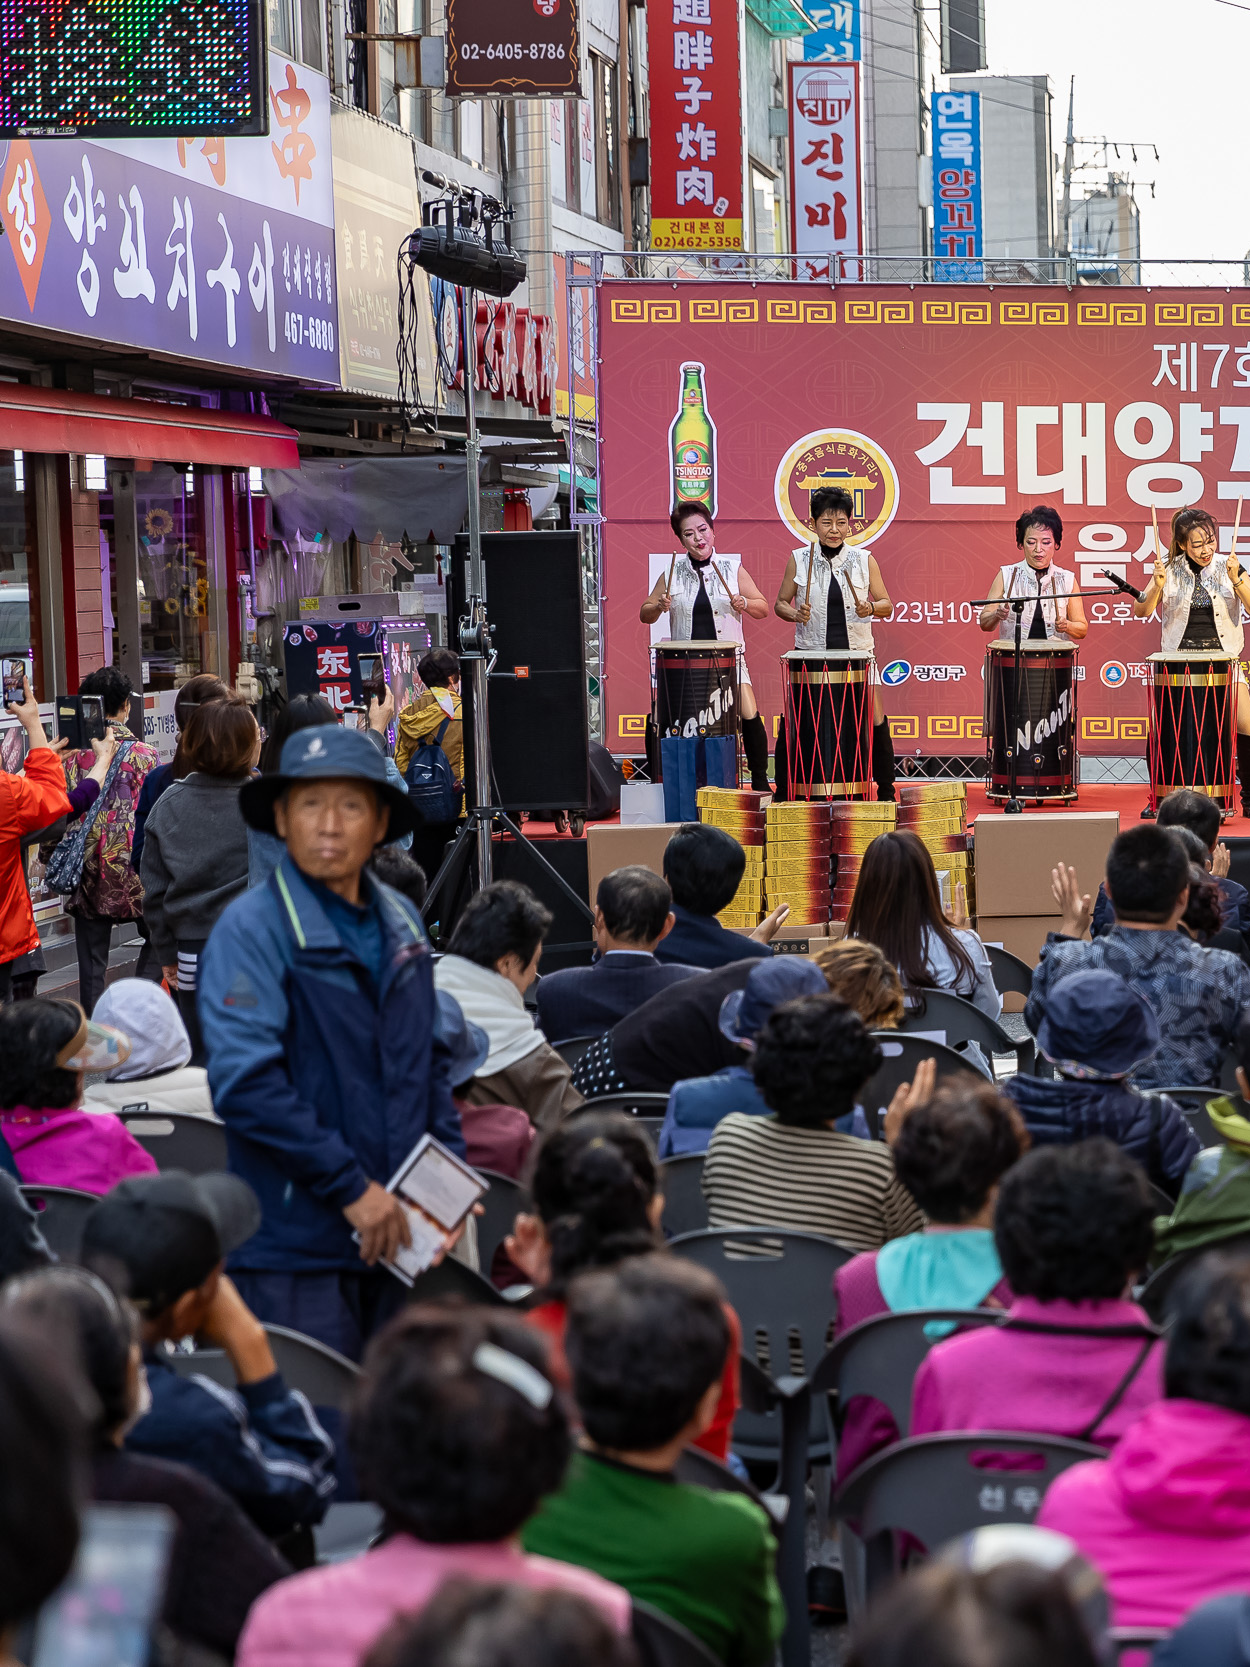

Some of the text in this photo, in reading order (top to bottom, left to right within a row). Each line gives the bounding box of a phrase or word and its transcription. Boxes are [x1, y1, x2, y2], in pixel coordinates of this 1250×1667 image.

[461, 43, 566, 60] 02-6405-8786
[669, 222, 725, 235] 건대본점
[654, 237, 741, 249] 02)462-5358
[63, 153, 277, 353] 양꼬치구이
[284, 311, 334, 353] 467-6880
[796, 443, 878, 474] 중국음식문화거리
[675, 466, 712, 476] TSINGTAO
[912, 665, 966, 681] 광진구
